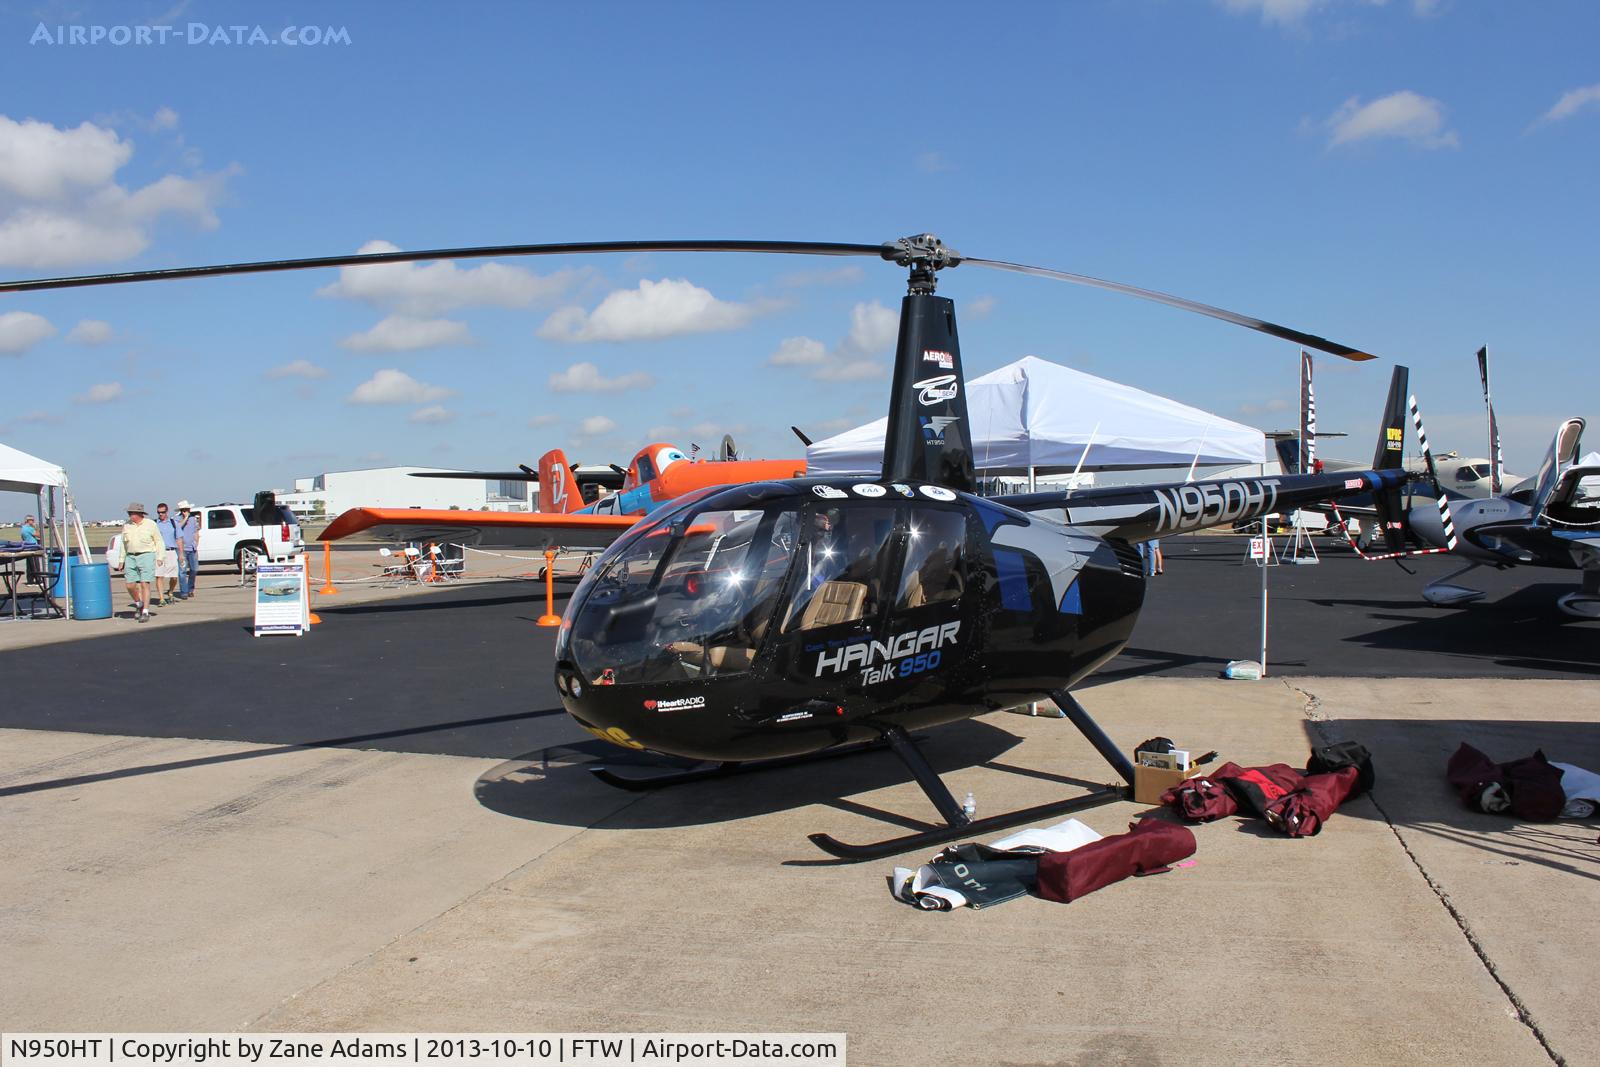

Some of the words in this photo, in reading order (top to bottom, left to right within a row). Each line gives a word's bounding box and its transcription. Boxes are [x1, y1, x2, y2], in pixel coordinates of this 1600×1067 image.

[1153, 479, 1282, 533] N950HT
[815, 620, 961, 677] HANGAR
[860, 661, 897, 687] Talk
[898, 650, 942, 678] 950
